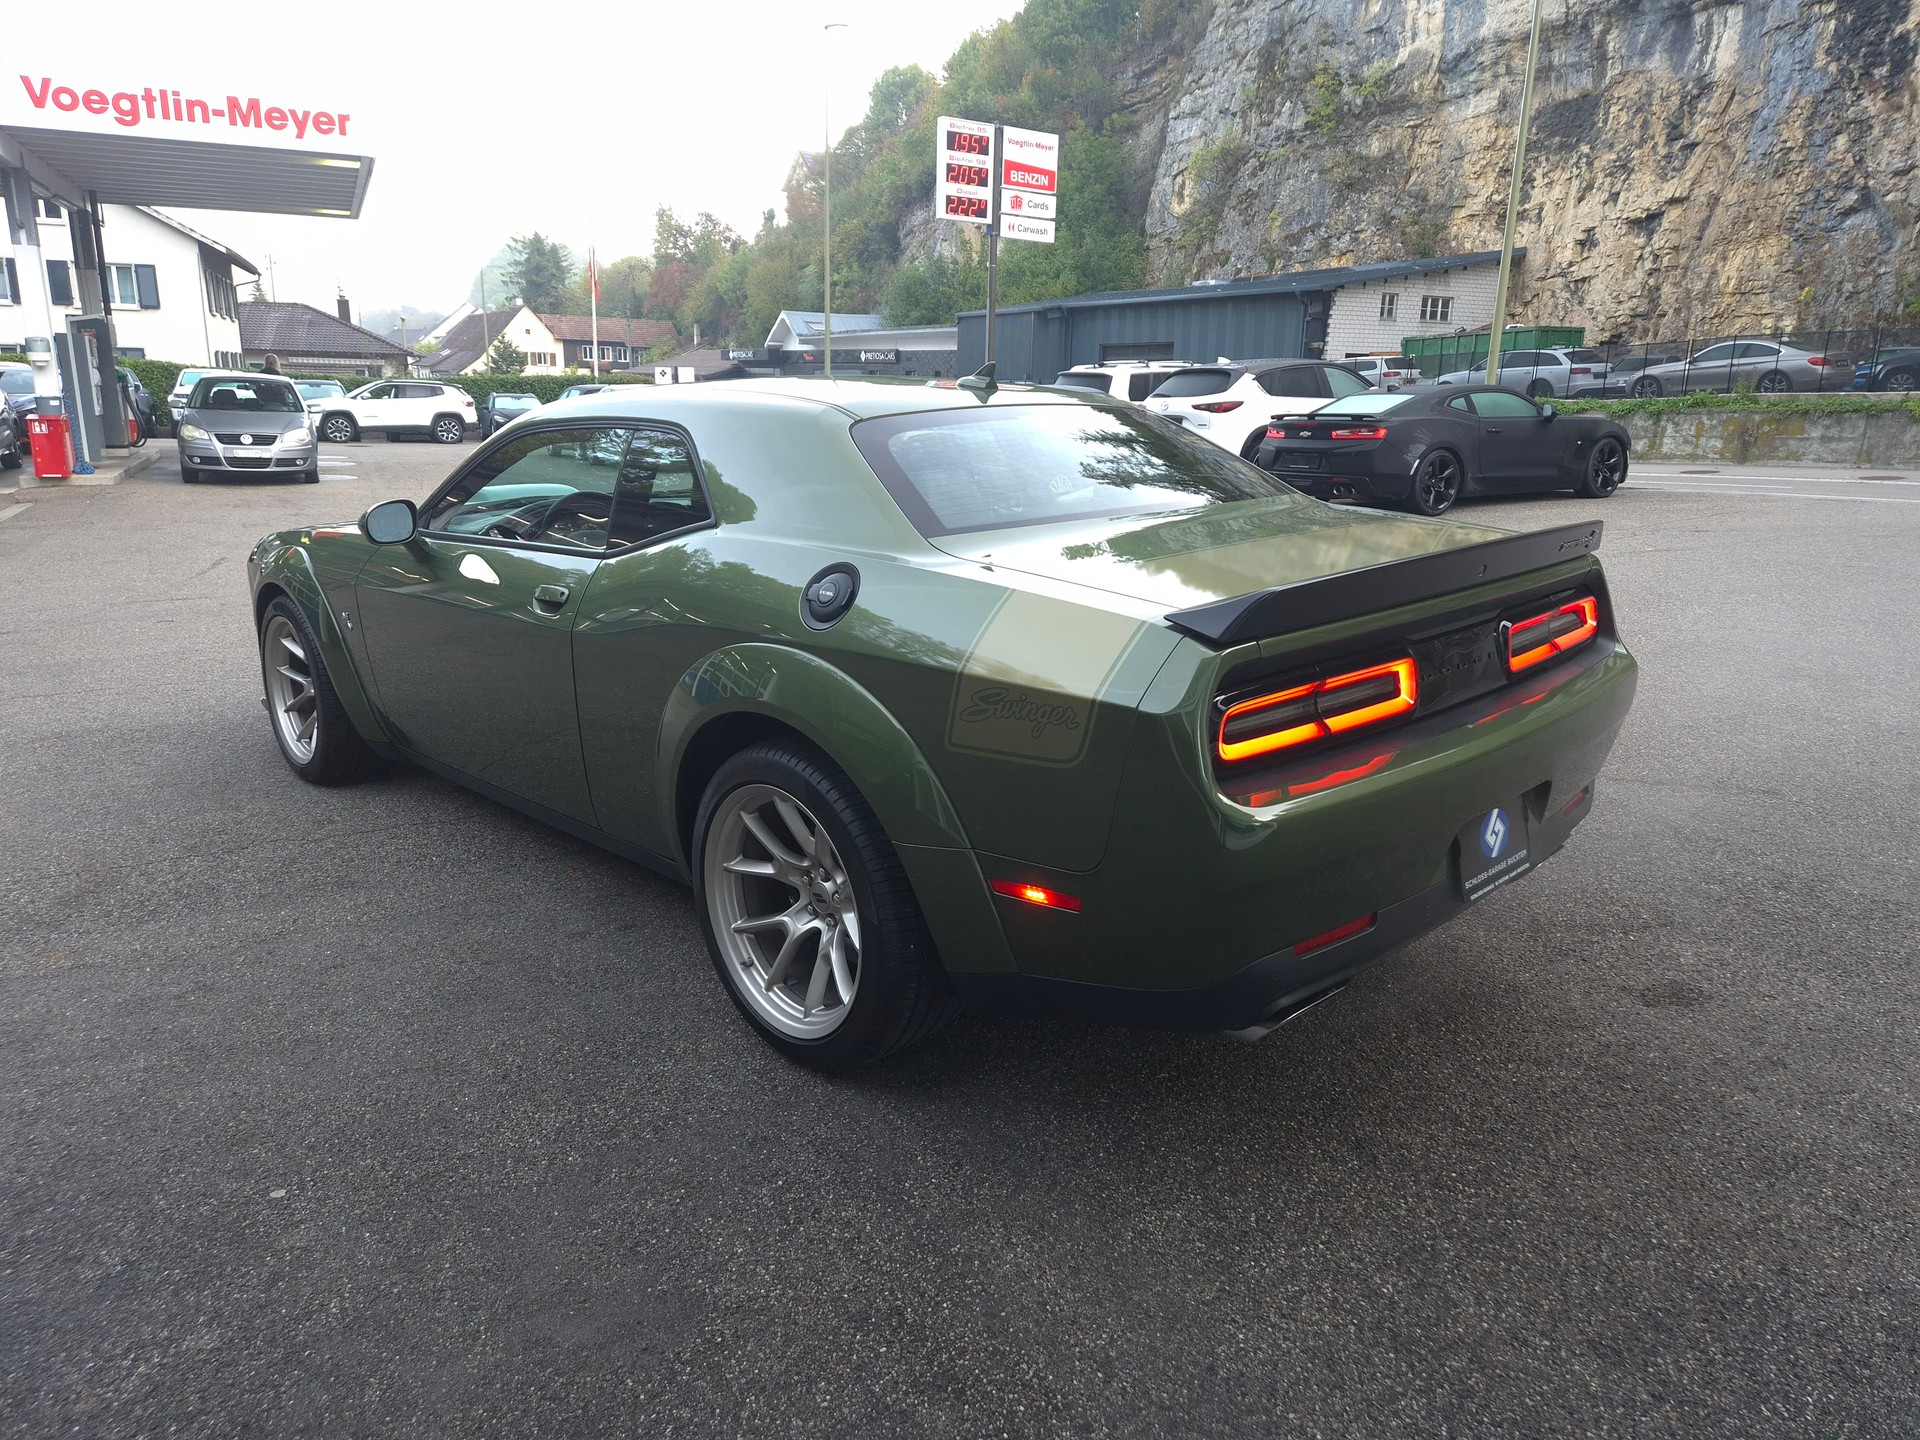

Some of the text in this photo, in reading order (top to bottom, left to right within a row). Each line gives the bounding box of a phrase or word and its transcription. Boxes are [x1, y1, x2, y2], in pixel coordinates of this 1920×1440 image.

[19, 75, 351, 139] Voegtlin-Meyer
[976, 126, 987, 134] 95
[1007, 137, 1055, 152] Voegtlin-Meyer
[1010, 169, 1049, 187] BENZIN
[956, 188, 978, 196] Diesel
[1027, 199, 1049, 211] Cards
[1017, 224, 1048, 236] Carwash
[959, 686, 1080, 739] Swinger
